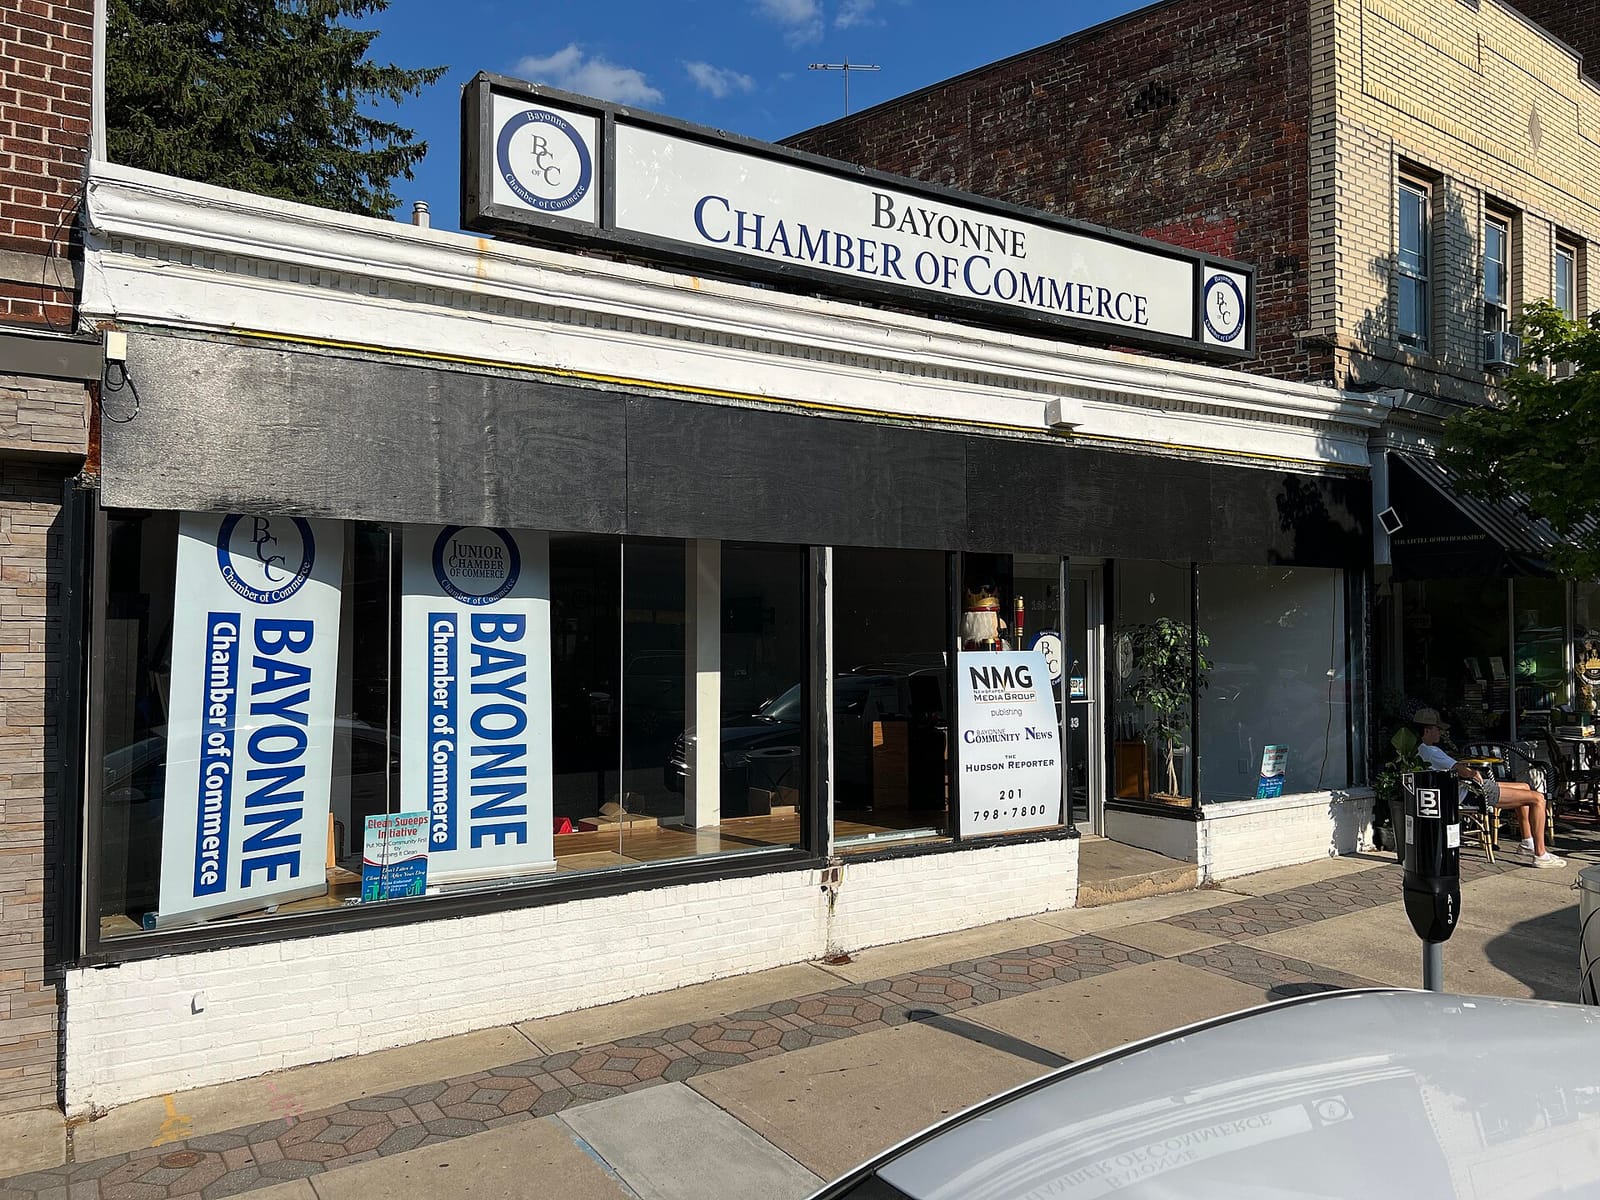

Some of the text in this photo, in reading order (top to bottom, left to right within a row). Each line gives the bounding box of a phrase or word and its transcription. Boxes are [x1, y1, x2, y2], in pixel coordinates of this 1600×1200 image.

[527, 111, 567, 129] Bayonne
[505, 173, 585, 209] Chamber of Commerce
[872, 192, 1027, 260] BAYONNE
[694, 195, 907, 281] CHAMBER
[452, 540, 503, 560] JUNIOR
[449, 556, 504, 570] CHAMBER
[450, 569, 504, 579] OF COMMERCE
[222, 561, 310, 602] Chamber of Commerce
[441, 579, 470, 603] Chamber
[482, 578, 515, 604] Commerce
[969, 665, 1033, 690] NMG
[432, 620, 455, 844] Chamber of Commerce
[470, 613, 528, 849] BAYONNE
[964, 726, 1053, 743] COMMUNITY NEWS
[200, 621, 237, 886] Chamber of Commerce
[240, 618, 314, 889] BAYONNE
[966, 759, 1055, 772] HUDSON REPORTER
[1000, 788, 1021, 800] 201
[1420, 790, 1436, 808] B
[395, 816, 429, 827] Sweeps
[378, 828, 418, 839] Intiative
